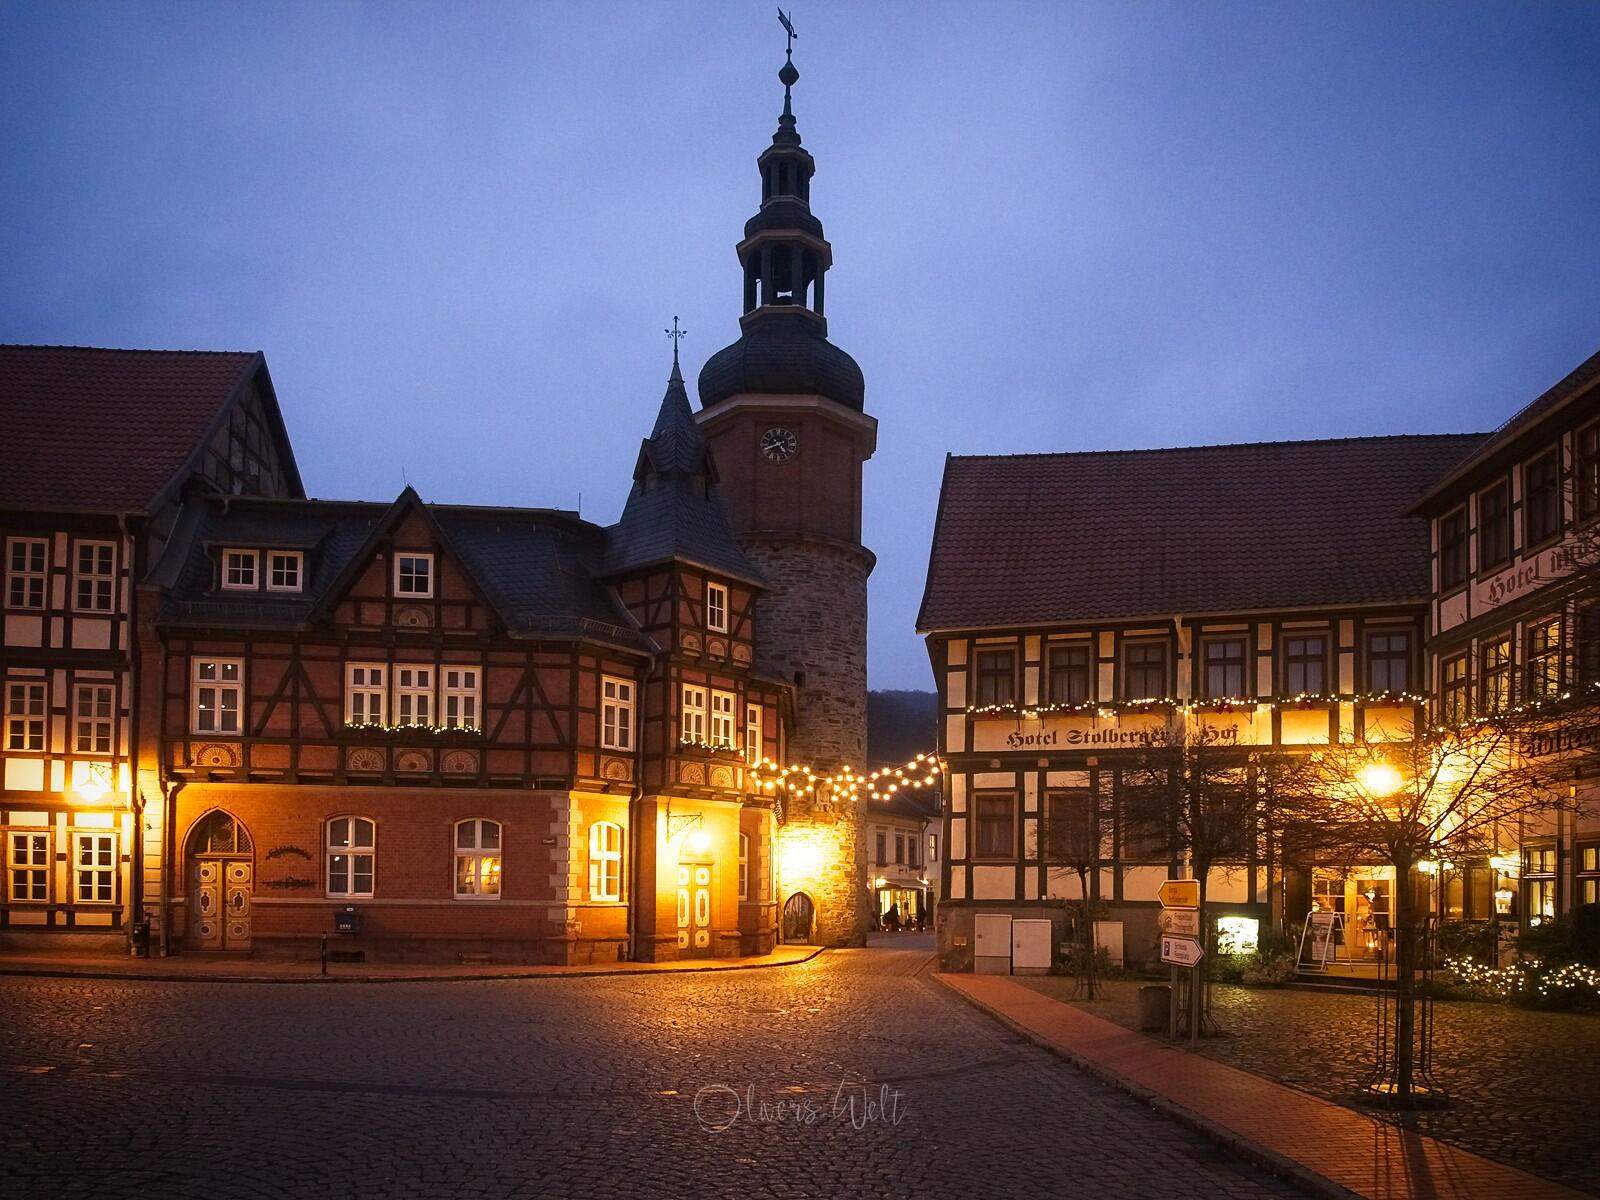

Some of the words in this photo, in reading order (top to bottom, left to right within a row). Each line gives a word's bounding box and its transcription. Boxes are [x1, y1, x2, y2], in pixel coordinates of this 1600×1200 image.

[1488, 555, 1540, 603] Hotel
[1006, 729, 1057, 748] Hotel
[1066, 728, 1171, 746] Stolberger
